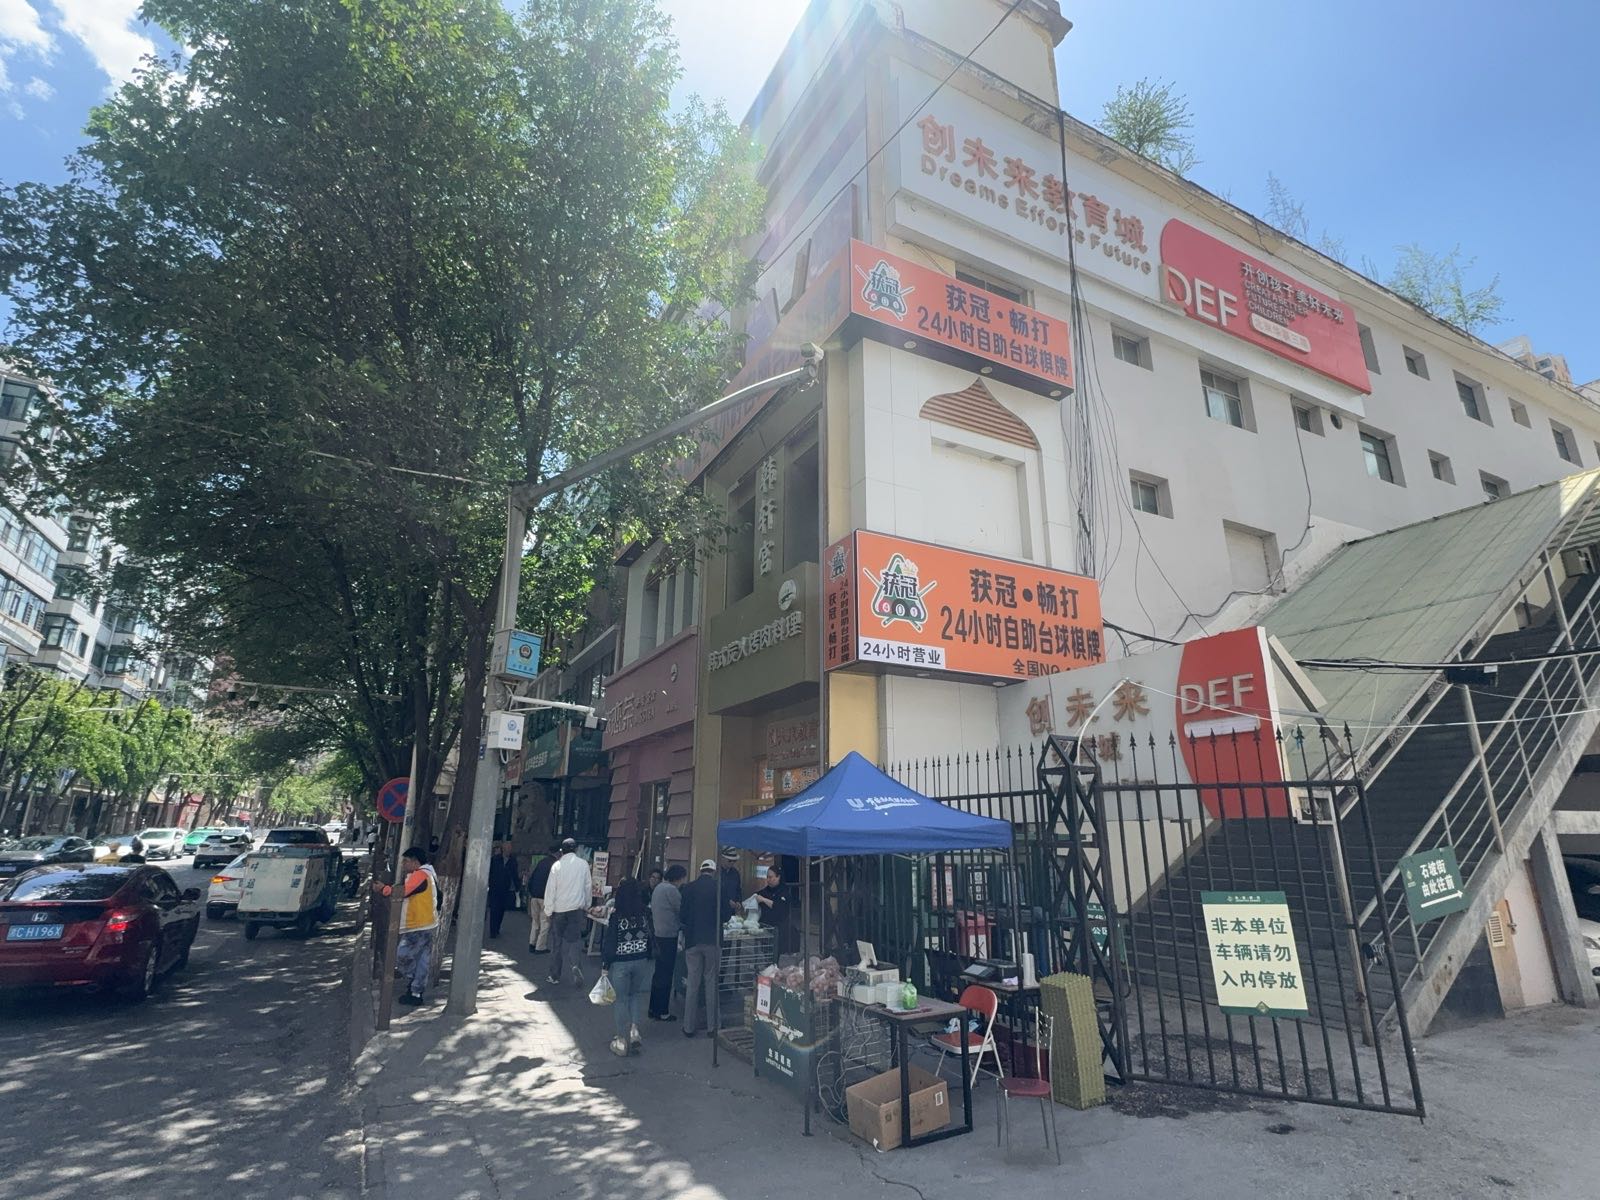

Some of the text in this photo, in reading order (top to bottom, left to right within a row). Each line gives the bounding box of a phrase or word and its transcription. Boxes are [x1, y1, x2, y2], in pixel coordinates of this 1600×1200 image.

[917, 114, 1148, 254] 创未来教育城
[921, 154, 1151, 275] Dreams Effors Future
[1166, 266, 1238, 327] DEF
[1246, 289, 1296, 320] FUTURE FOR
[1248, 300, 1289, 326] CHILDREN
[917, 306, 1070, 380] 24小时自助台球棋牌
[882, 571, 918, 599] 获冠
[940, 605, 1101, 663] 24小时自助台球棋牌
[862, 641, 941, 665] 24小时营业
[1025, 681, 1150, 736] 创未来
[1180, 673, 1255, 715] DEF
[1420, 860, 1446, 879] 石坡街
[1422, 874, 1455, 897] 由此往前
[1211, 917, 1288, 935] 非本单位
[1215, 943, 1292, 962] 车辆请勿
[1221, 970, 1298, 990] 入内停放
